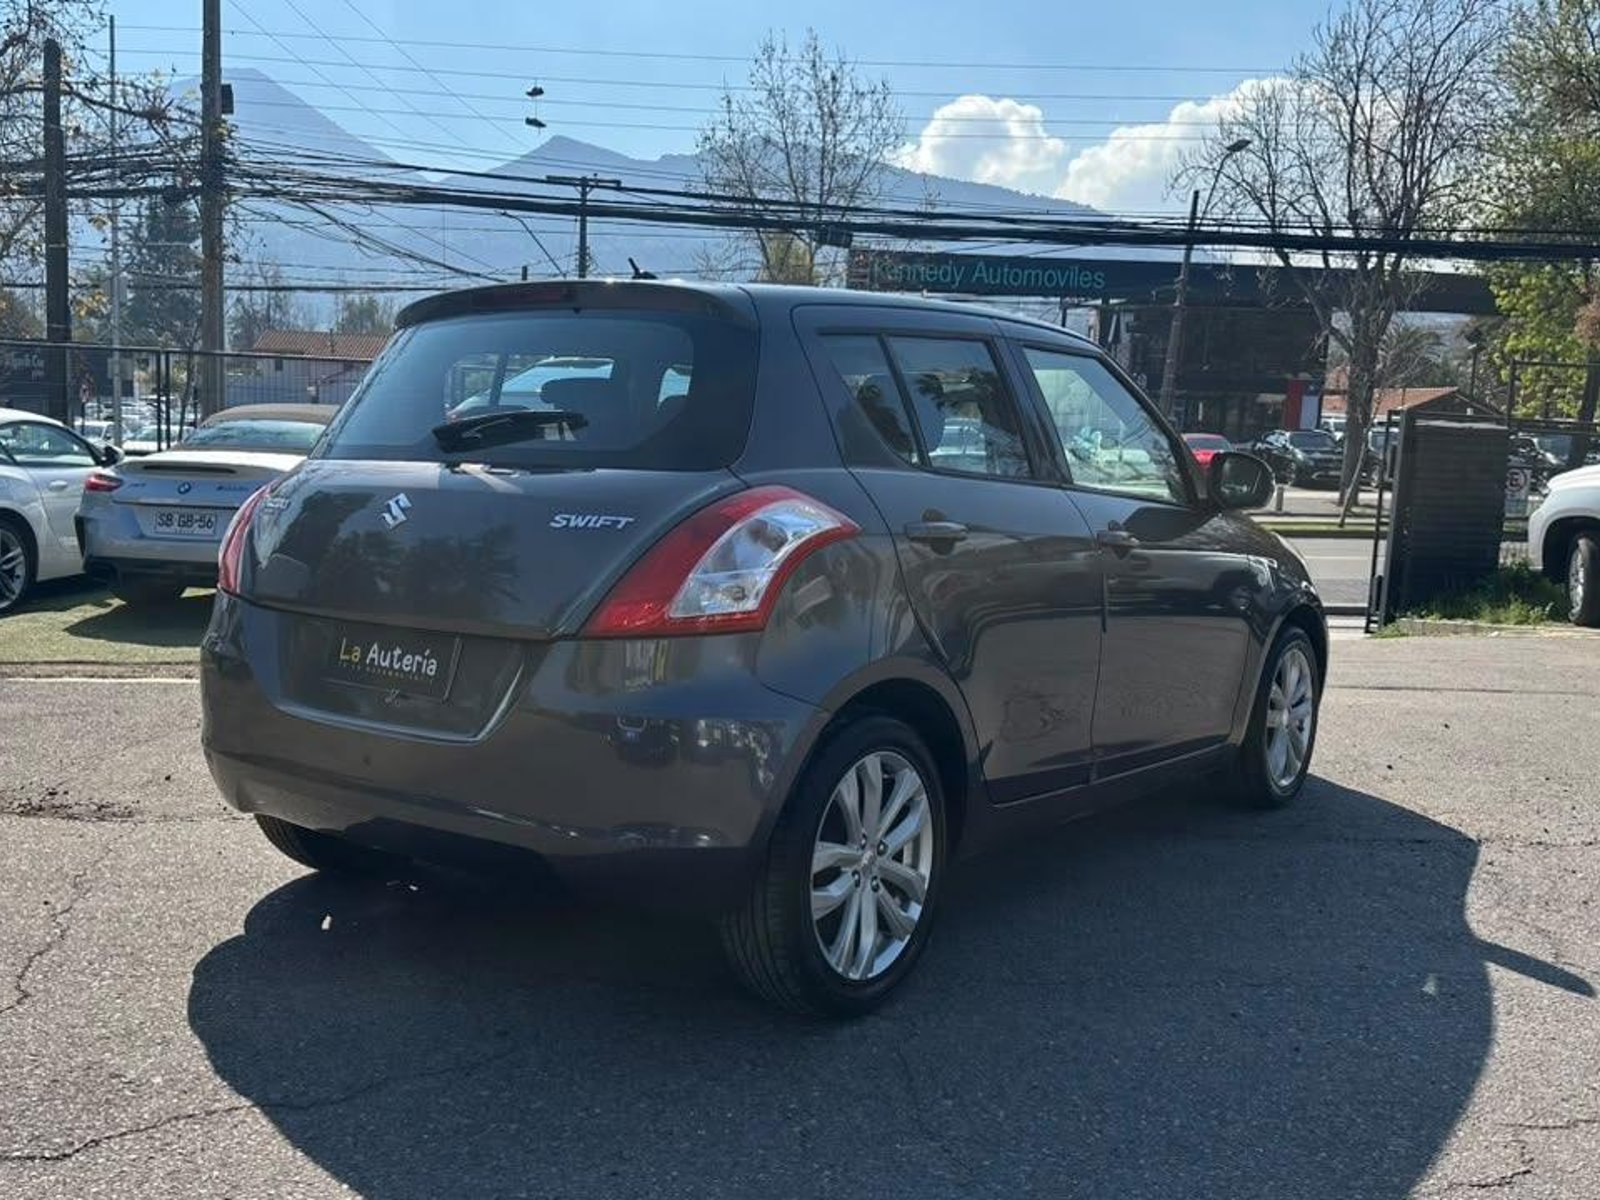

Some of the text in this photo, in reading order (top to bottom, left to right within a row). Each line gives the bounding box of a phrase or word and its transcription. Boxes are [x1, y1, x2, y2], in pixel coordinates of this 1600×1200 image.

[873, 260, 1106, 289] Kennedy Automoviles
[549, 514, 635, 529] SWIFT
[340, 637, 361, 662] La
[366, 642, 438, 676] Autería
